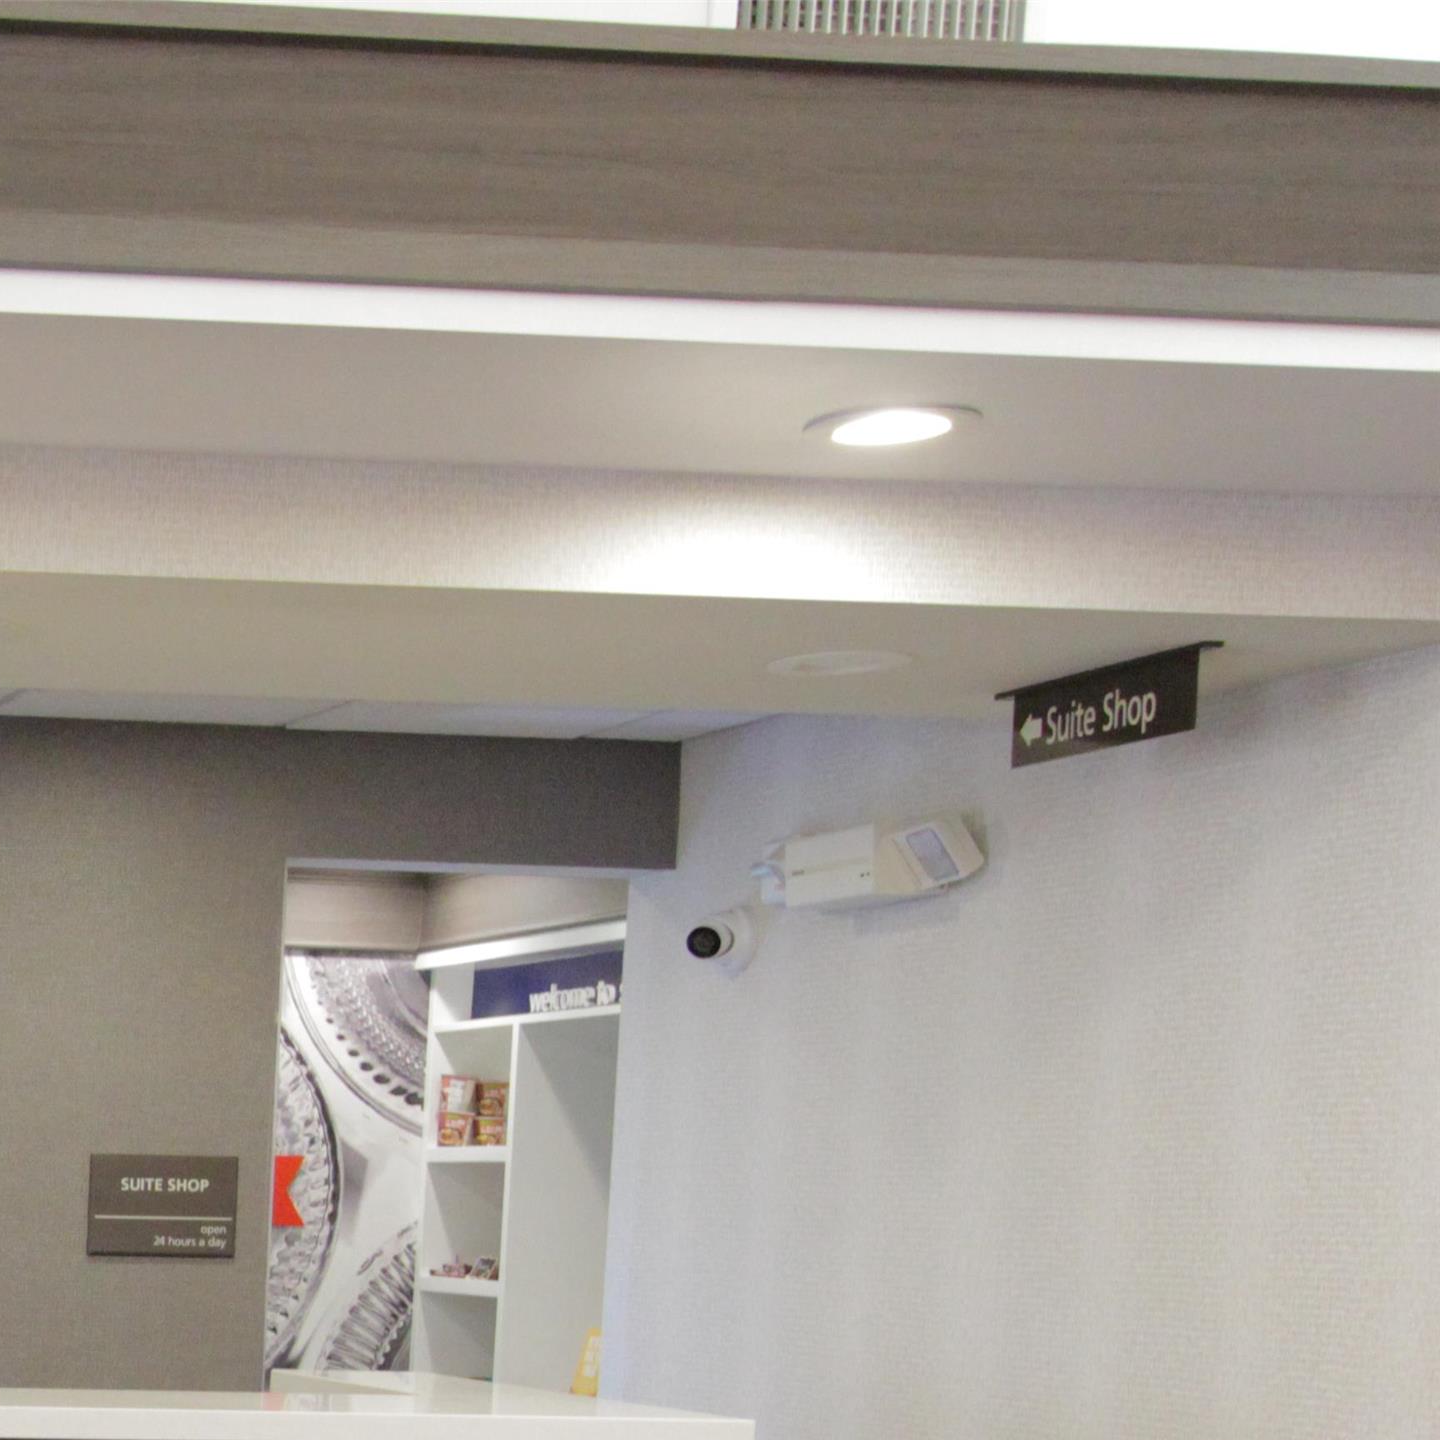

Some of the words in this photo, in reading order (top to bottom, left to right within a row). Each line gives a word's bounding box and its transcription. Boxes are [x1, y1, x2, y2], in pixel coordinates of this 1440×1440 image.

[1045, 700, 1097, 745] Suite
[1102, 688, 1157, 734] Shop
[528, 983, 596, 1013] welcome
[120, 1176, 164, 1192] SUITE
[167, 1177, 210, 1193] SHOP
[200, 1226, 227, 1237] open
[153, 1235, 165, 1247] 24
[167, 1235, 197, 1248] hours
[198, 1238, 206, 1247] a
[207, 1236, 227, 1250] day
